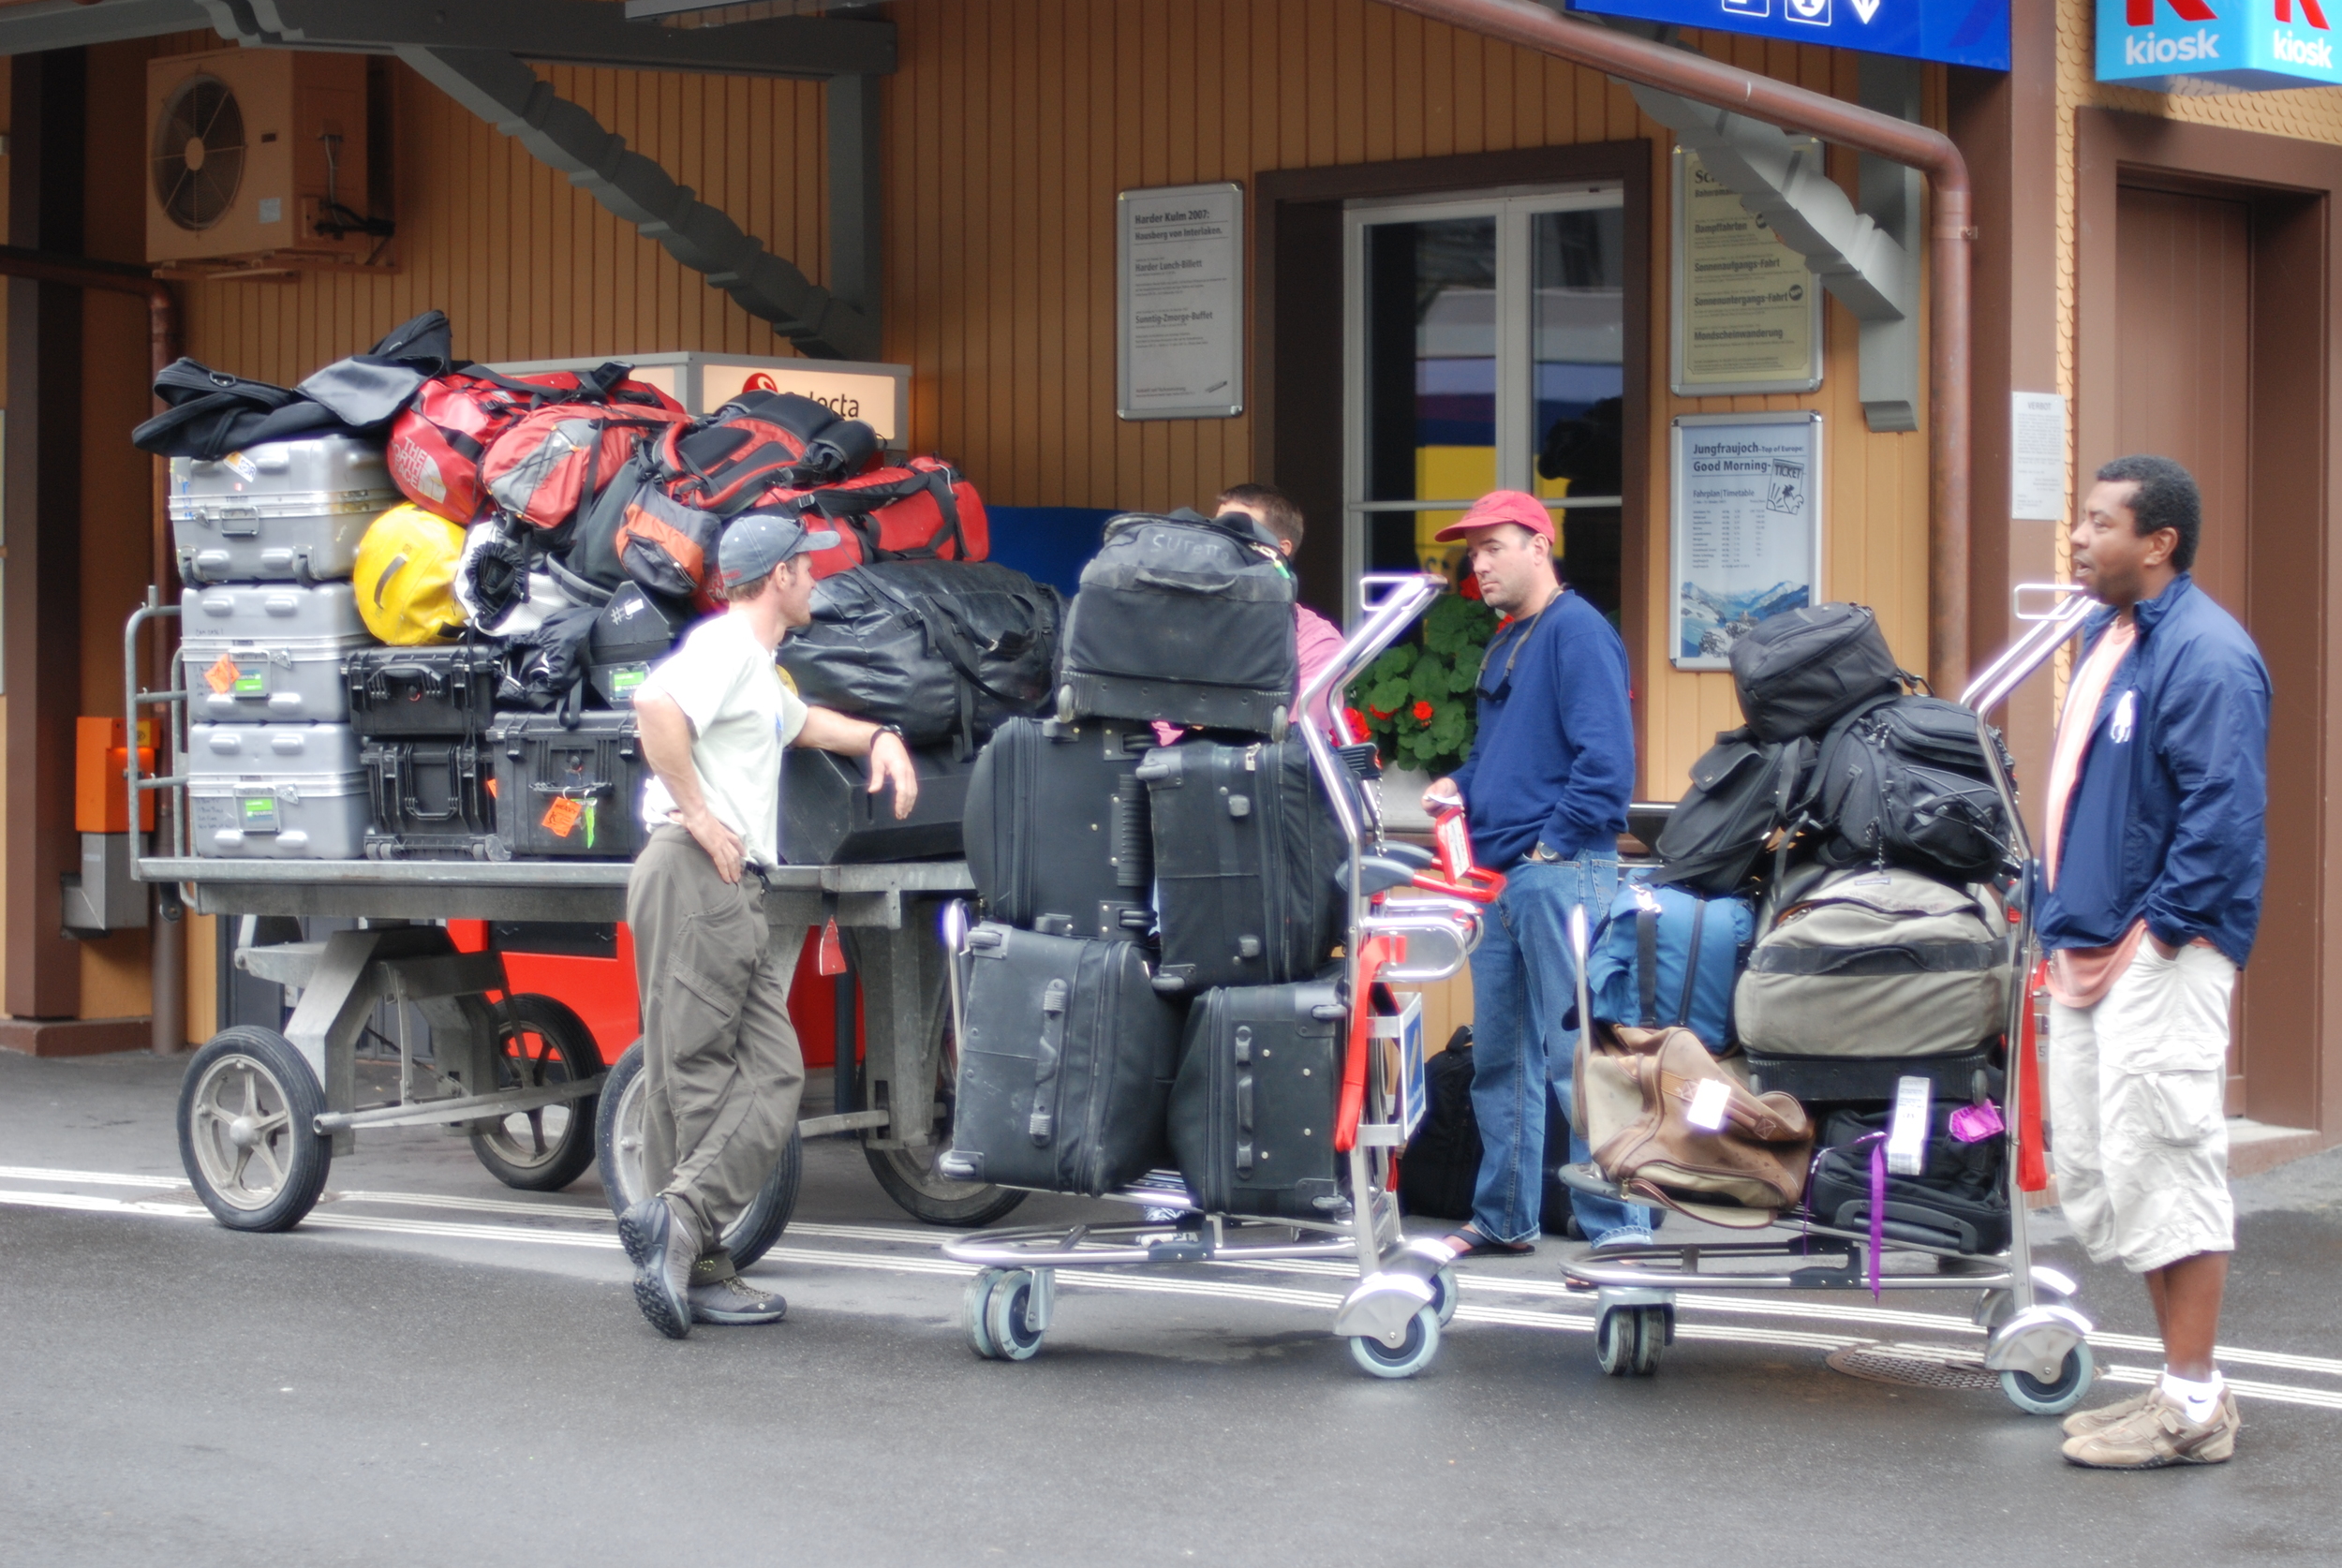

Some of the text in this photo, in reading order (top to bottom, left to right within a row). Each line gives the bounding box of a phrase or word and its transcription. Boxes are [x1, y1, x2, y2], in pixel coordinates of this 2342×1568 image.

[2125, 28, 2220, 66] kiosk
[2273, 28, 2333, 69] kiosk
[1134, 209, 1210, 224] Harder Kulm 2007:
[1134, 227, 1223, 241] Hausberg von Interlaken.
[1695, 222, 1747, 234] Dampffahrten
[1135, 262, 1158, 272] Harder
[1160, 259, 1203, 270] Lunch-Billett
[1695, 258, 1780, 273] Sonnenaufgangs-Fahrt
[1695, 292, 1788, 306] Sonnenuntergangs-Fahrt
[1135, 311, 1213, 325] Sunntig-Zmorge-Buffet
[1694, 329, 1784, 341] Mondscheinwanderung
[2027, 402, 2052, 410] VERBOT
[404, 436, 428, 466] THE
[1693, 459, 1771, 473] Good Morning-
[1774, 464, 1802, 480] TICKET
